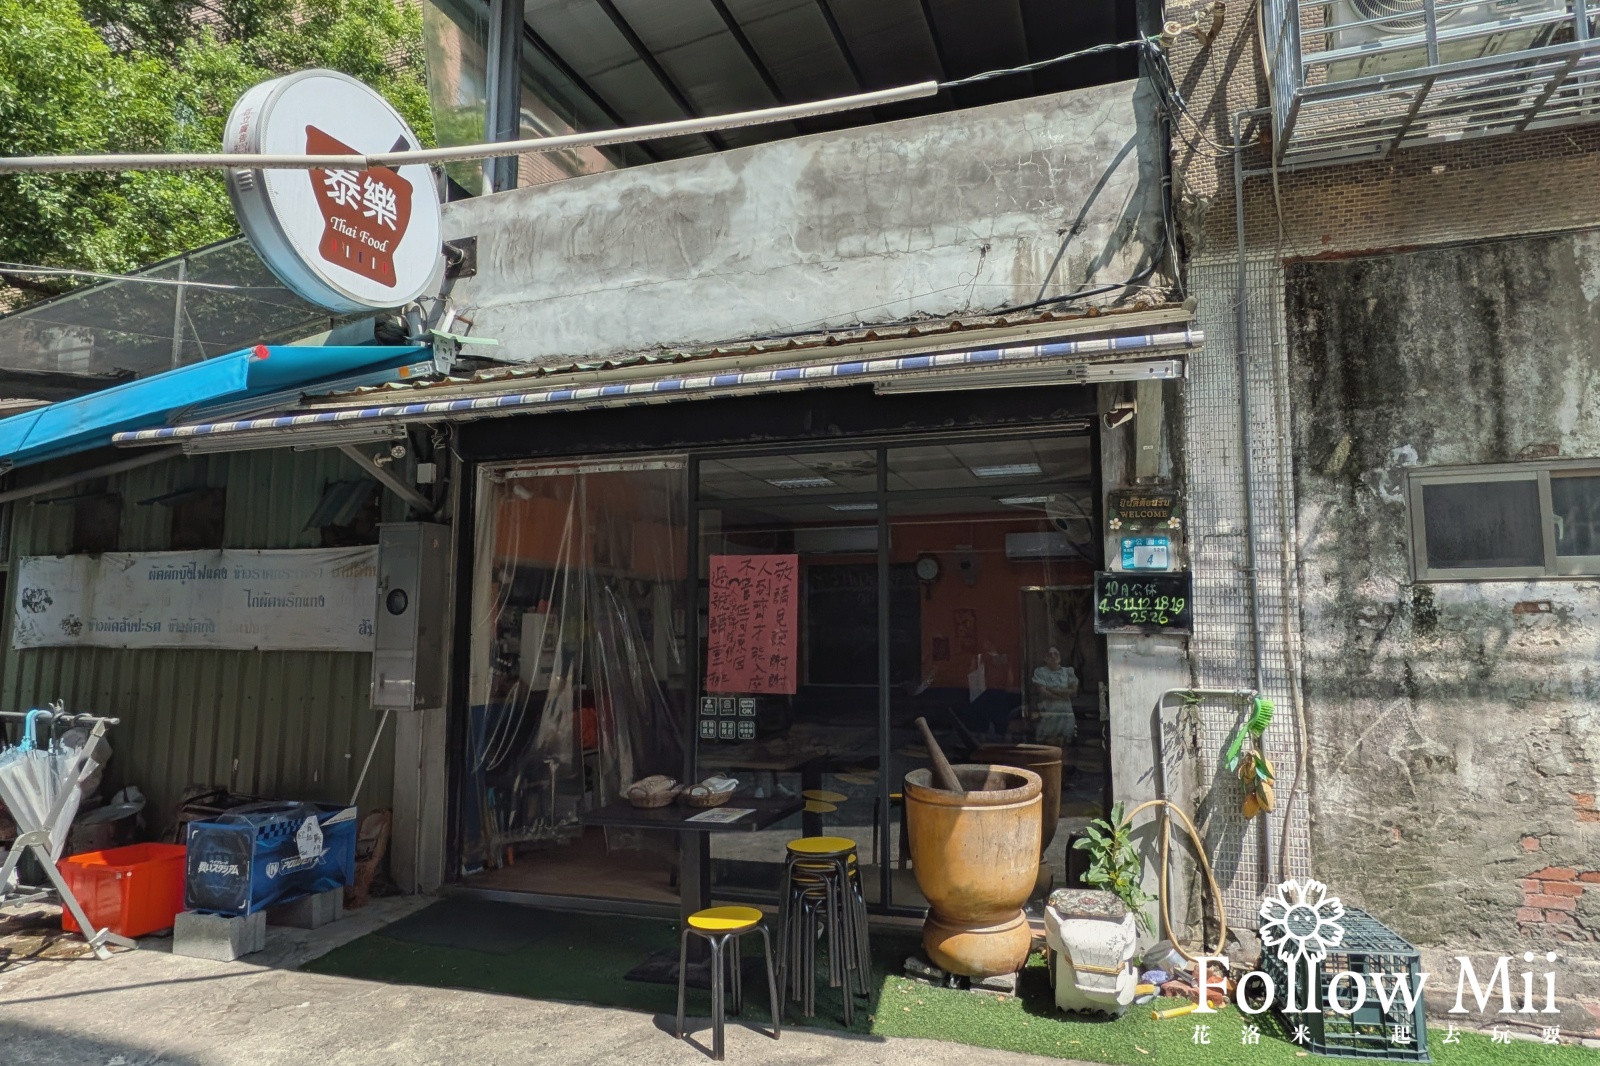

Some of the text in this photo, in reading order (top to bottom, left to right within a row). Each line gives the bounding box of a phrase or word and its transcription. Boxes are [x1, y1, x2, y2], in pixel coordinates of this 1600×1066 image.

[324, 168, 398, 231] 泰樂
[330, 216, 389, 253] Thai Food
[1120, 510, 1168, 518] WELCOME
[1146, 554, 1153, 565] 4
[1104, 580, 1157, 597] 10月公休
